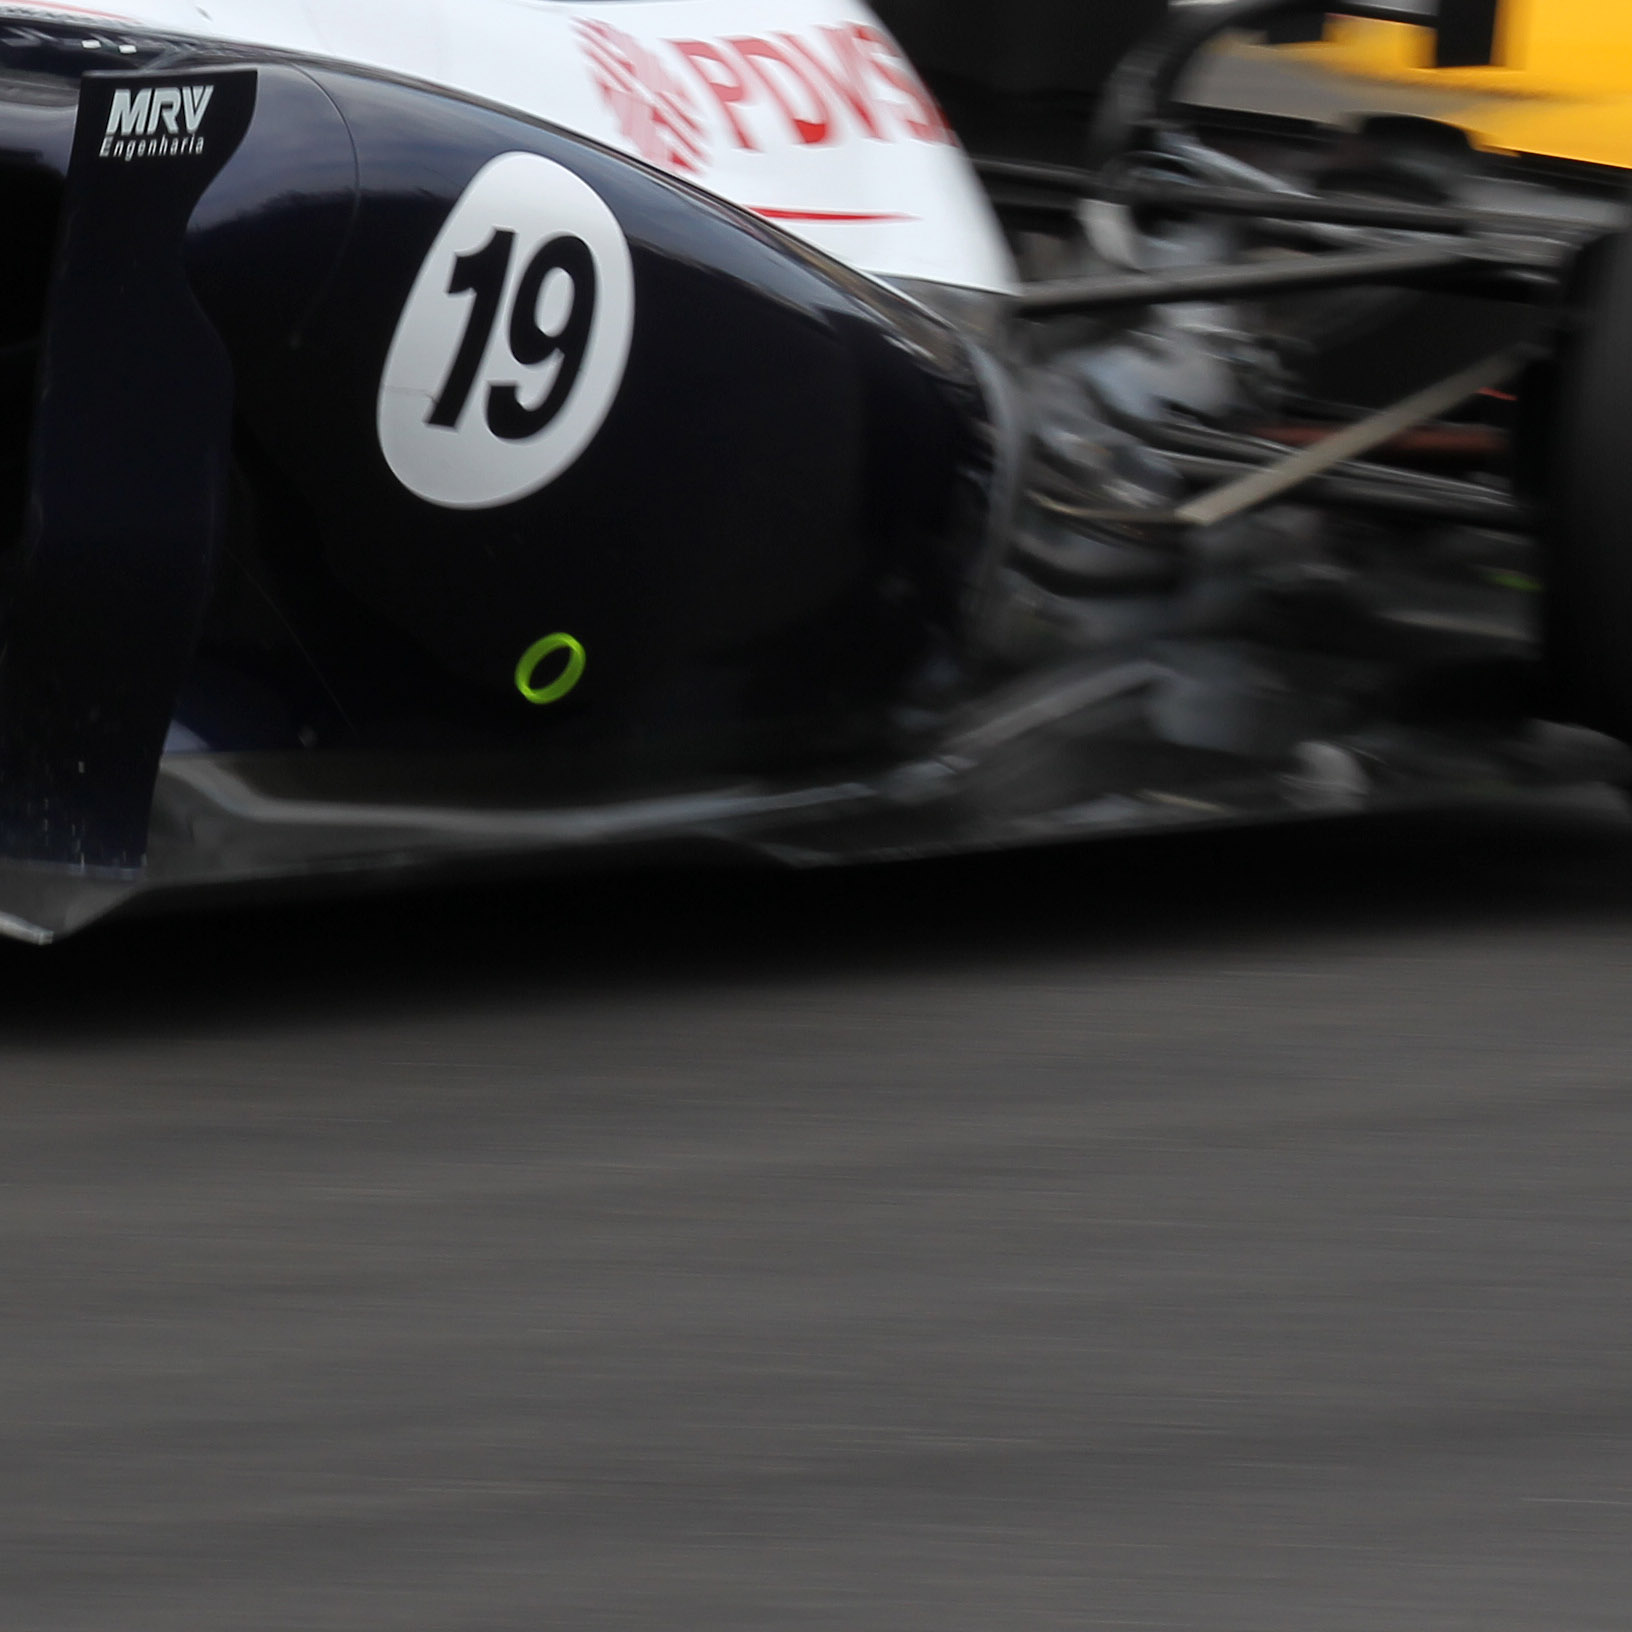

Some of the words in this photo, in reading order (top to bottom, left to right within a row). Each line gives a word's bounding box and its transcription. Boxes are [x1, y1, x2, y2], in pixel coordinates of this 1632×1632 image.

[105, 85, 215, 137] MRV
[98, 134, 206, 162] Engenharia
[422, 227, 599, 446] 19
